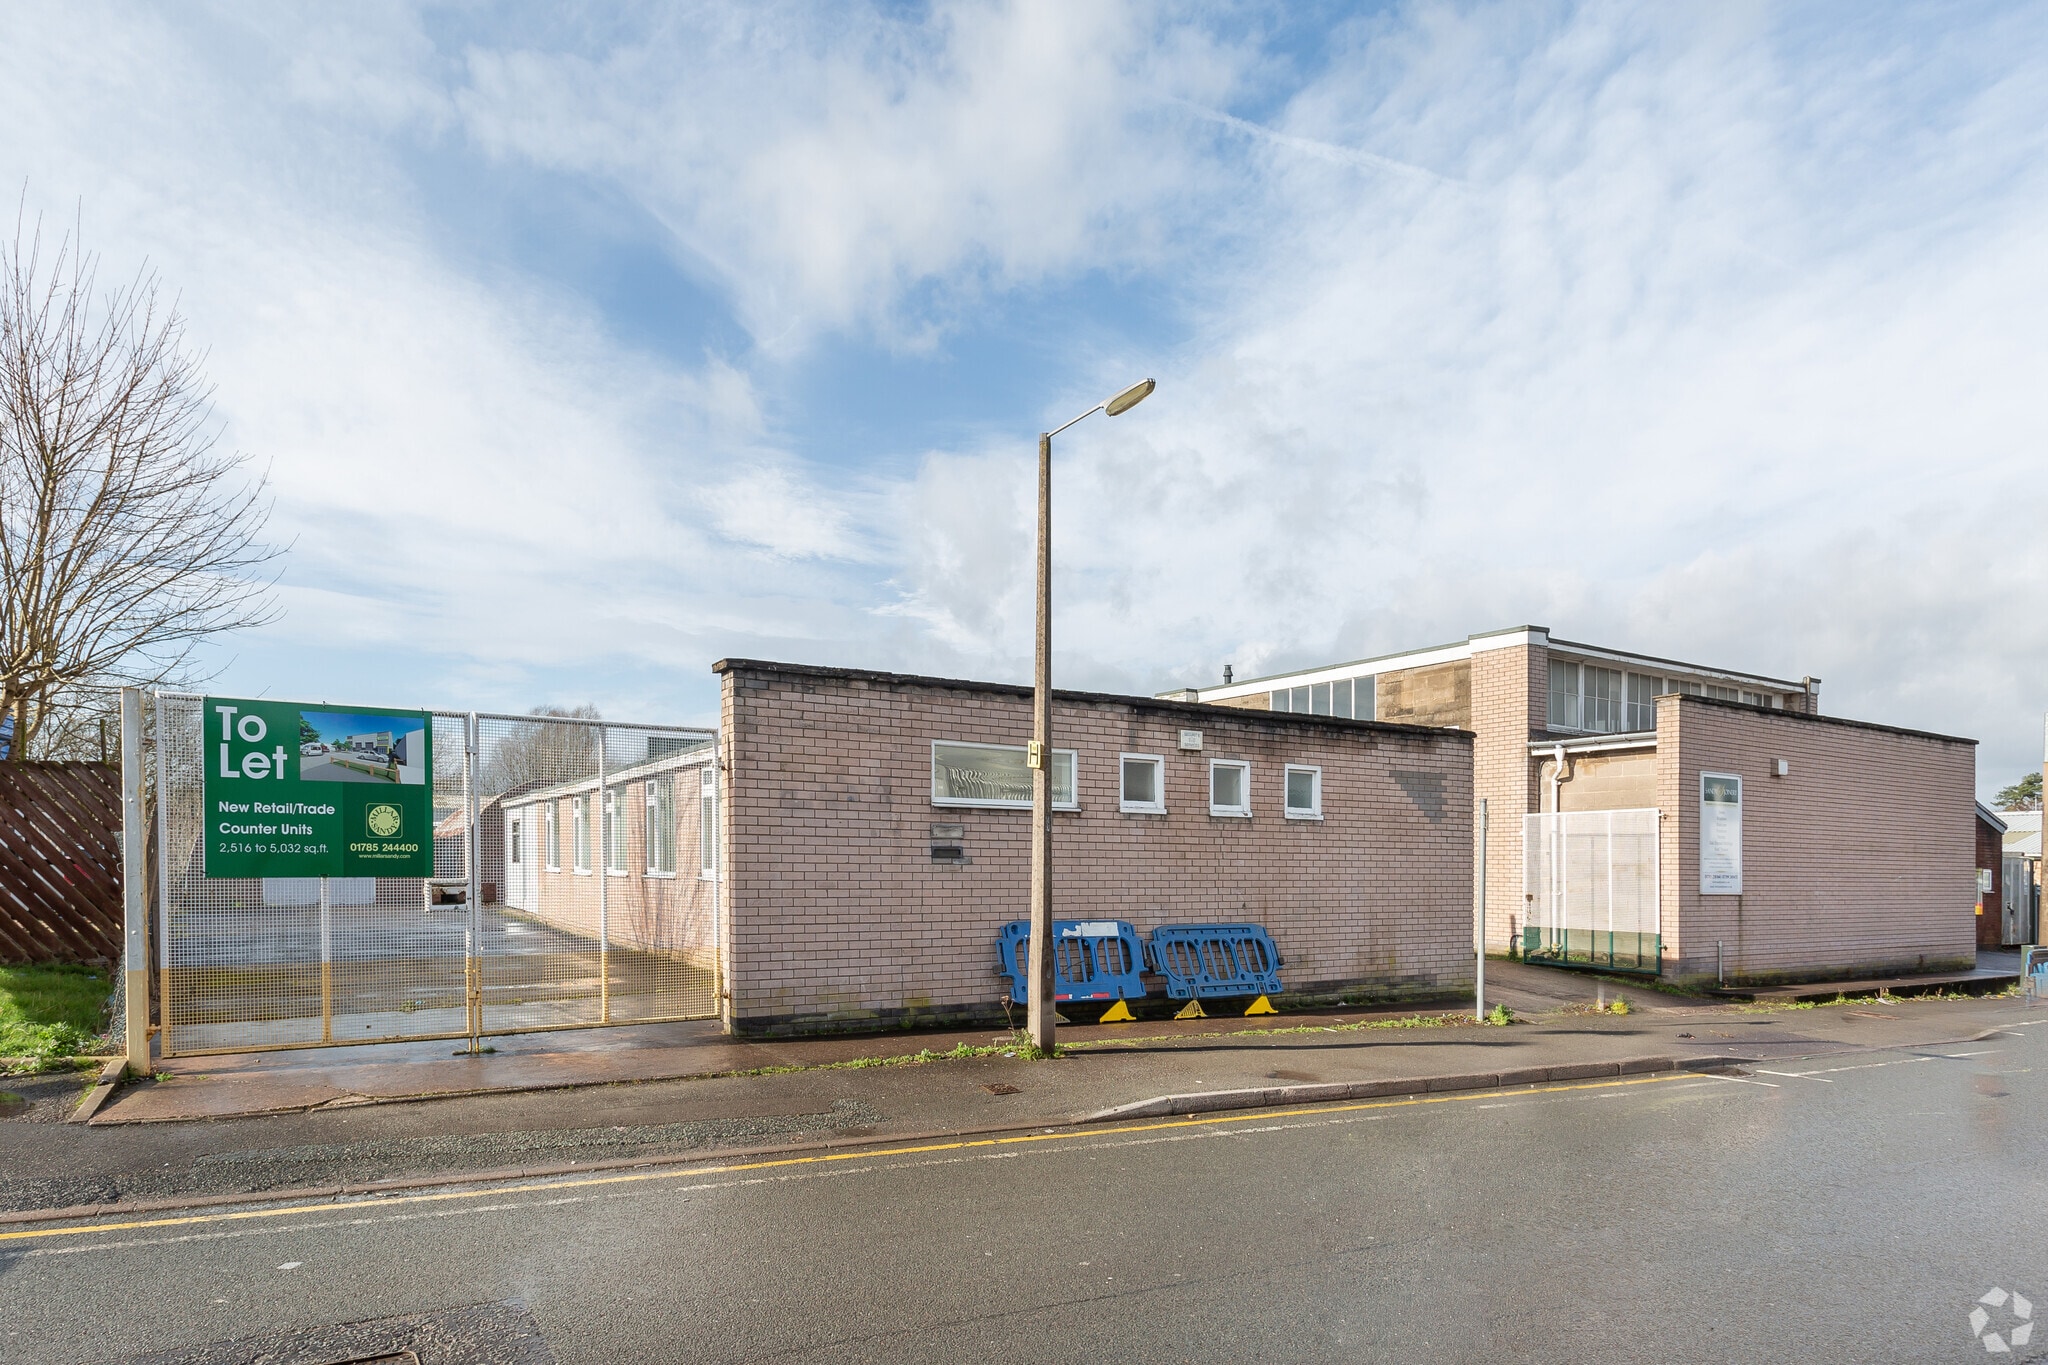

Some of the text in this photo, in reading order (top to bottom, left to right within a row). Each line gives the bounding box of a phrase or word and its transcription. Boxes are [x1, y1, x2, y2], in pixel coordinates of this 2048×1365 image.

[215, 705, 267, 743] To
[220, 742, 288, 780] Let
[1029, 743, 1039, 766] H
[218, 801, 336, 816] New Retail/Trade
[370, 806, 399, 822] MILLAR
[219, 822, 313, 836] Counter Units
[371, 822, 398, 835] SANDY
[219, 842, 329, 855] 2,516 to 5,032 sq.ft.
[350, 842, 419, 852] 01785 244400
